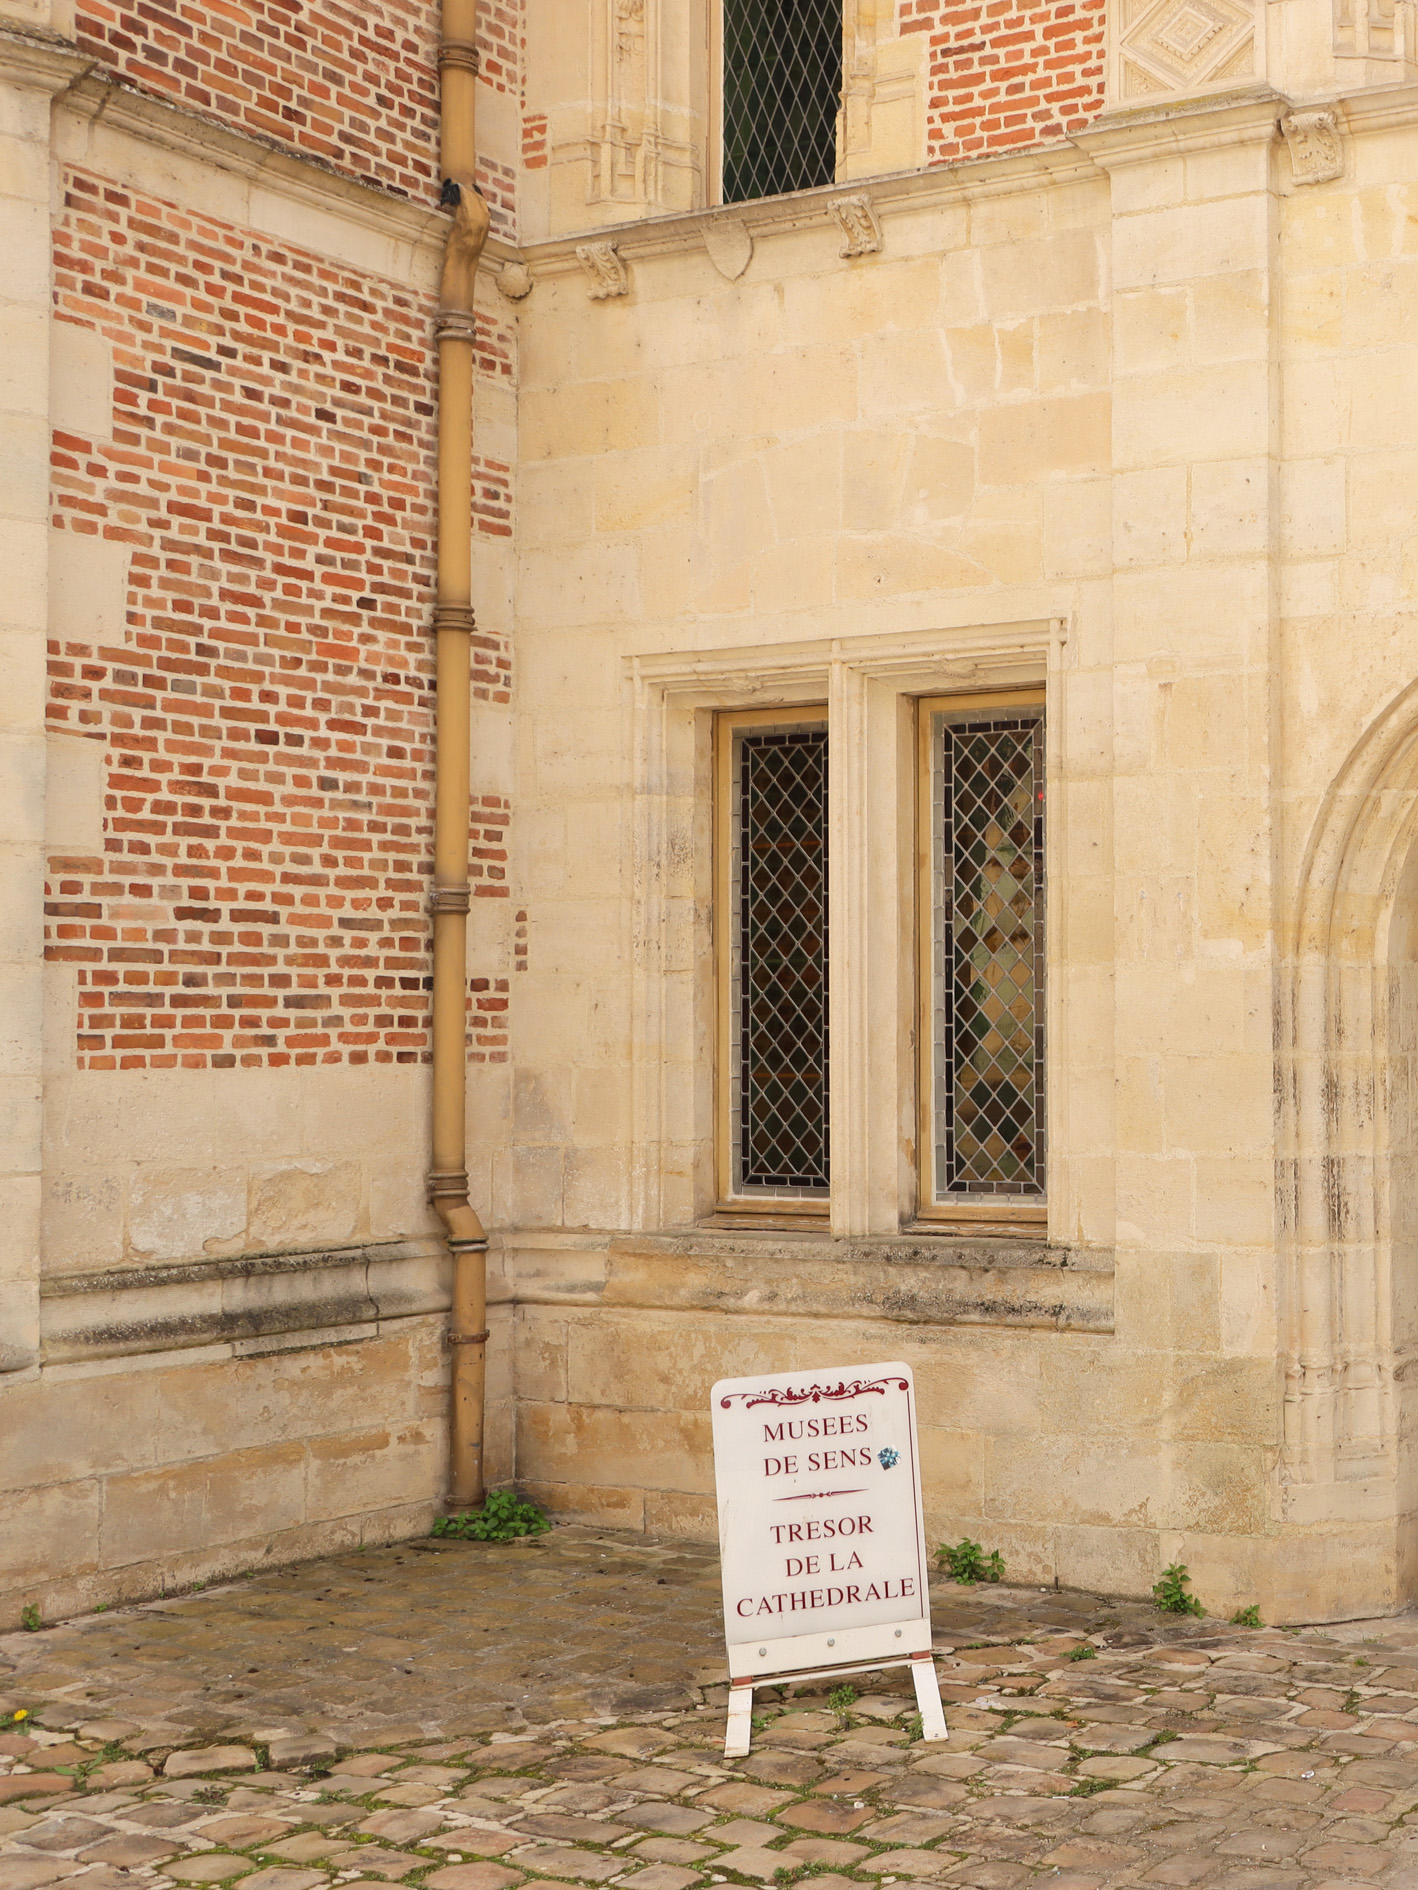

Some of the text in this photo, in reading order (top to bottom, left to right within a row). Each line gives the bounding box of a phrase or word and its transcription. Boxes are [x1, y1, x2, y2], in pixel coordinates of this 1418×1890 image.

[763, 1413, 869, 1443] MUSEES
[763, 1447, 872, 1477] DE SENS
[770, 1515, 874, 1545] TRESOR
[785, 1550, 864, 1578] DE LA
[736, 1577, 916, 1618] CATHEDRALE
